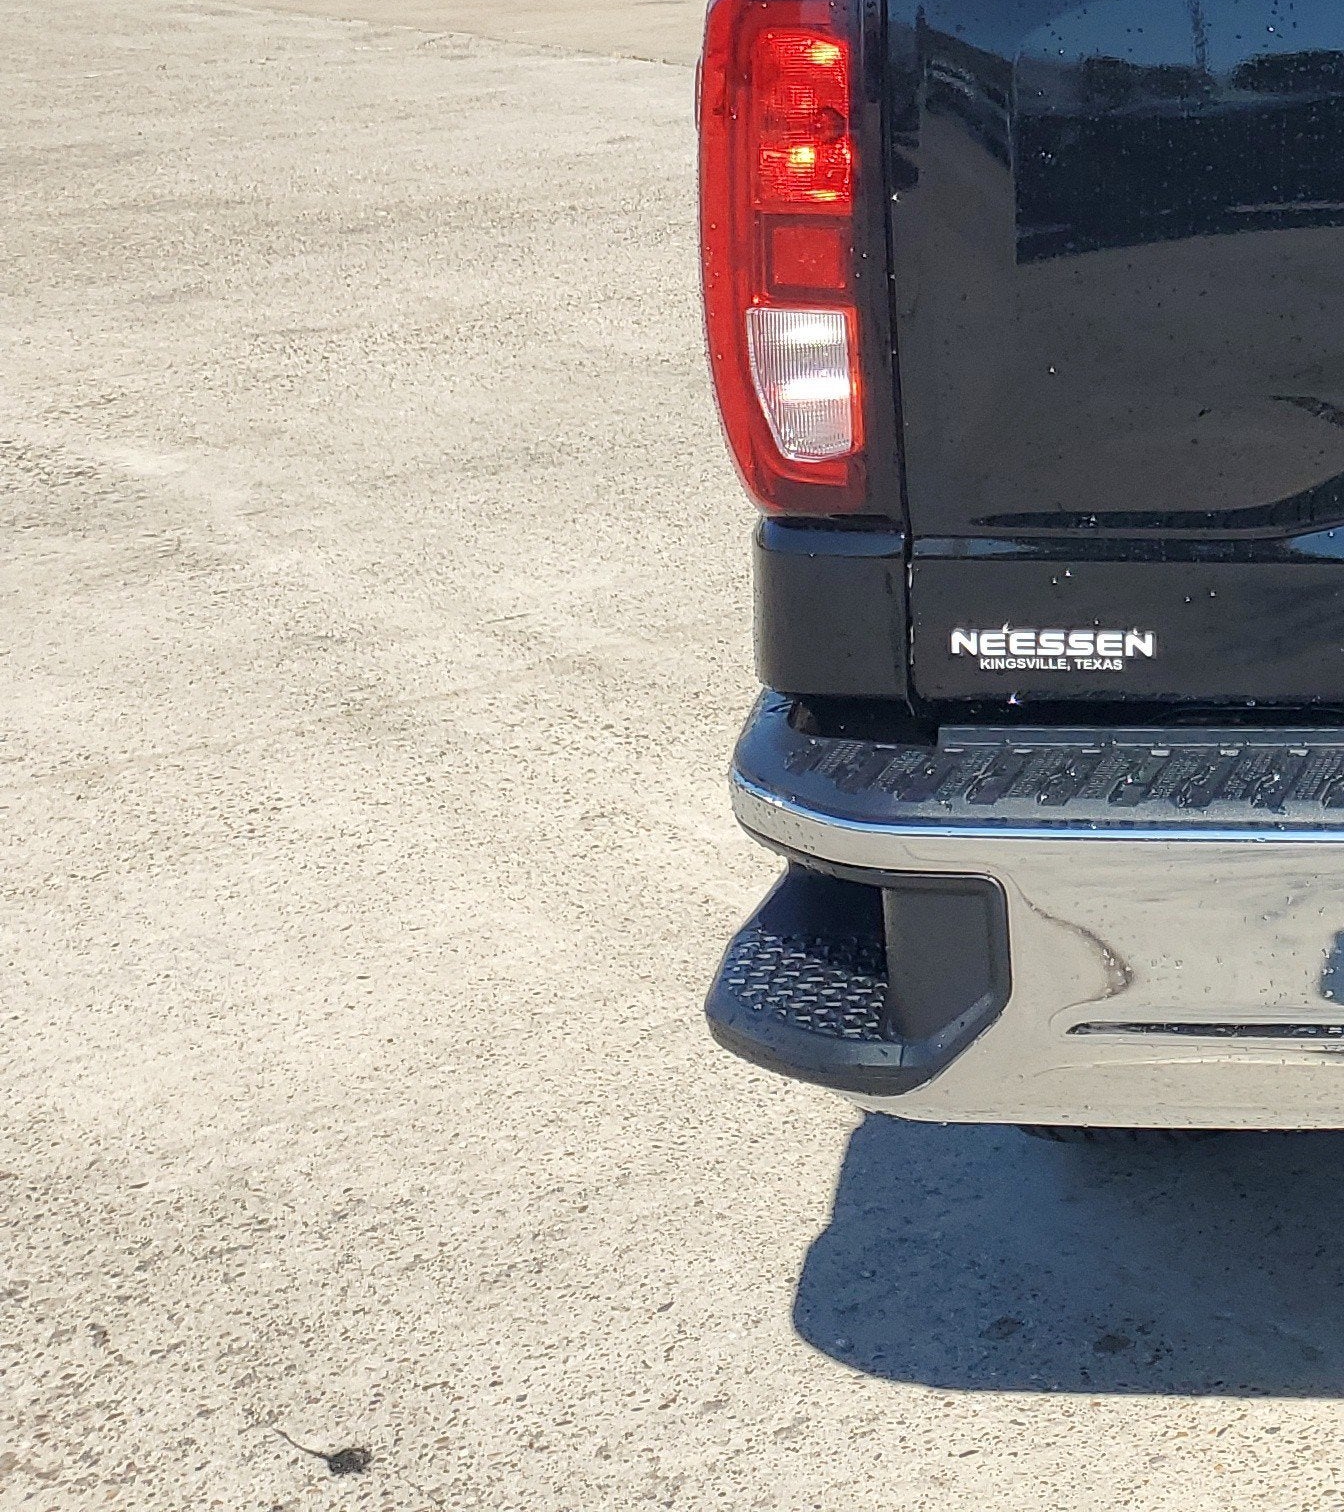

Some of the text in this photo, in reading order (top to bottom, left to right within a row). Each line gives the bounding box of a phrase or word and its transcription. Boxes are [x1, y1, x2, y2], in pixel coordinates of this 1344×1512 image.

[950, 628, 1156, 658] NEESSEN
[980, 658, 1123, 672] KINGSVILLE, TEXAS
